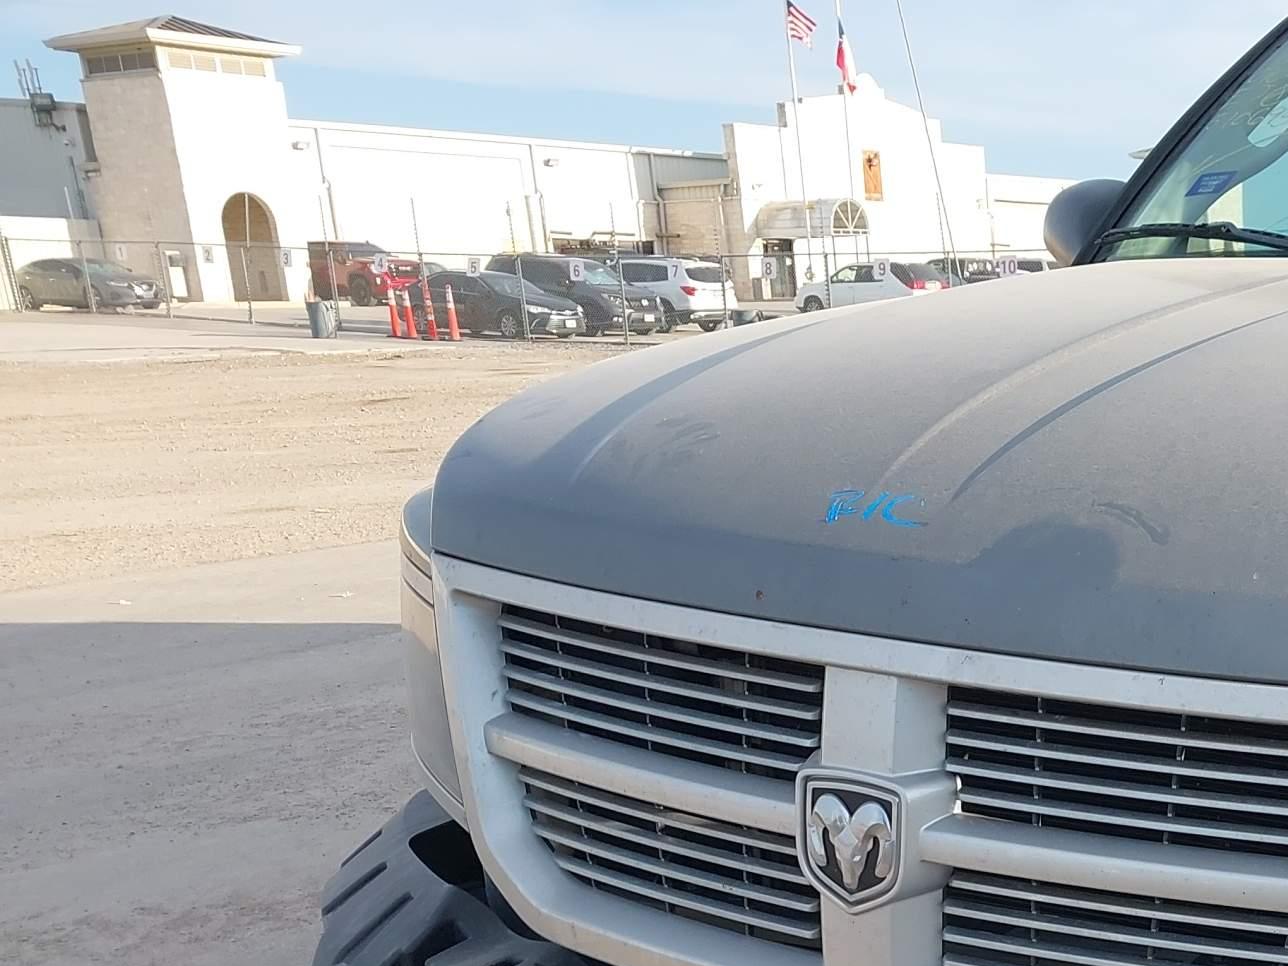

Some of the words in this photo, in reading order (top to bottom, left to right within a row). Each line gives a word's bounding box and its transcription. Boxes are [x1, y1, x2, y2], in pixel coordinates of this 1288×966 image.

[283, 252, 290, 265] 3
[376, 258, 384, 269] 4
[470, 261, 478, 273] 5
[573, 264, 581, 277] 6
[671, 264, 678, 278] 7
[764, 262, 772, 276] 8
[878, 262, 886, 276] 9
[1001, 260, 1016, 274] 10
